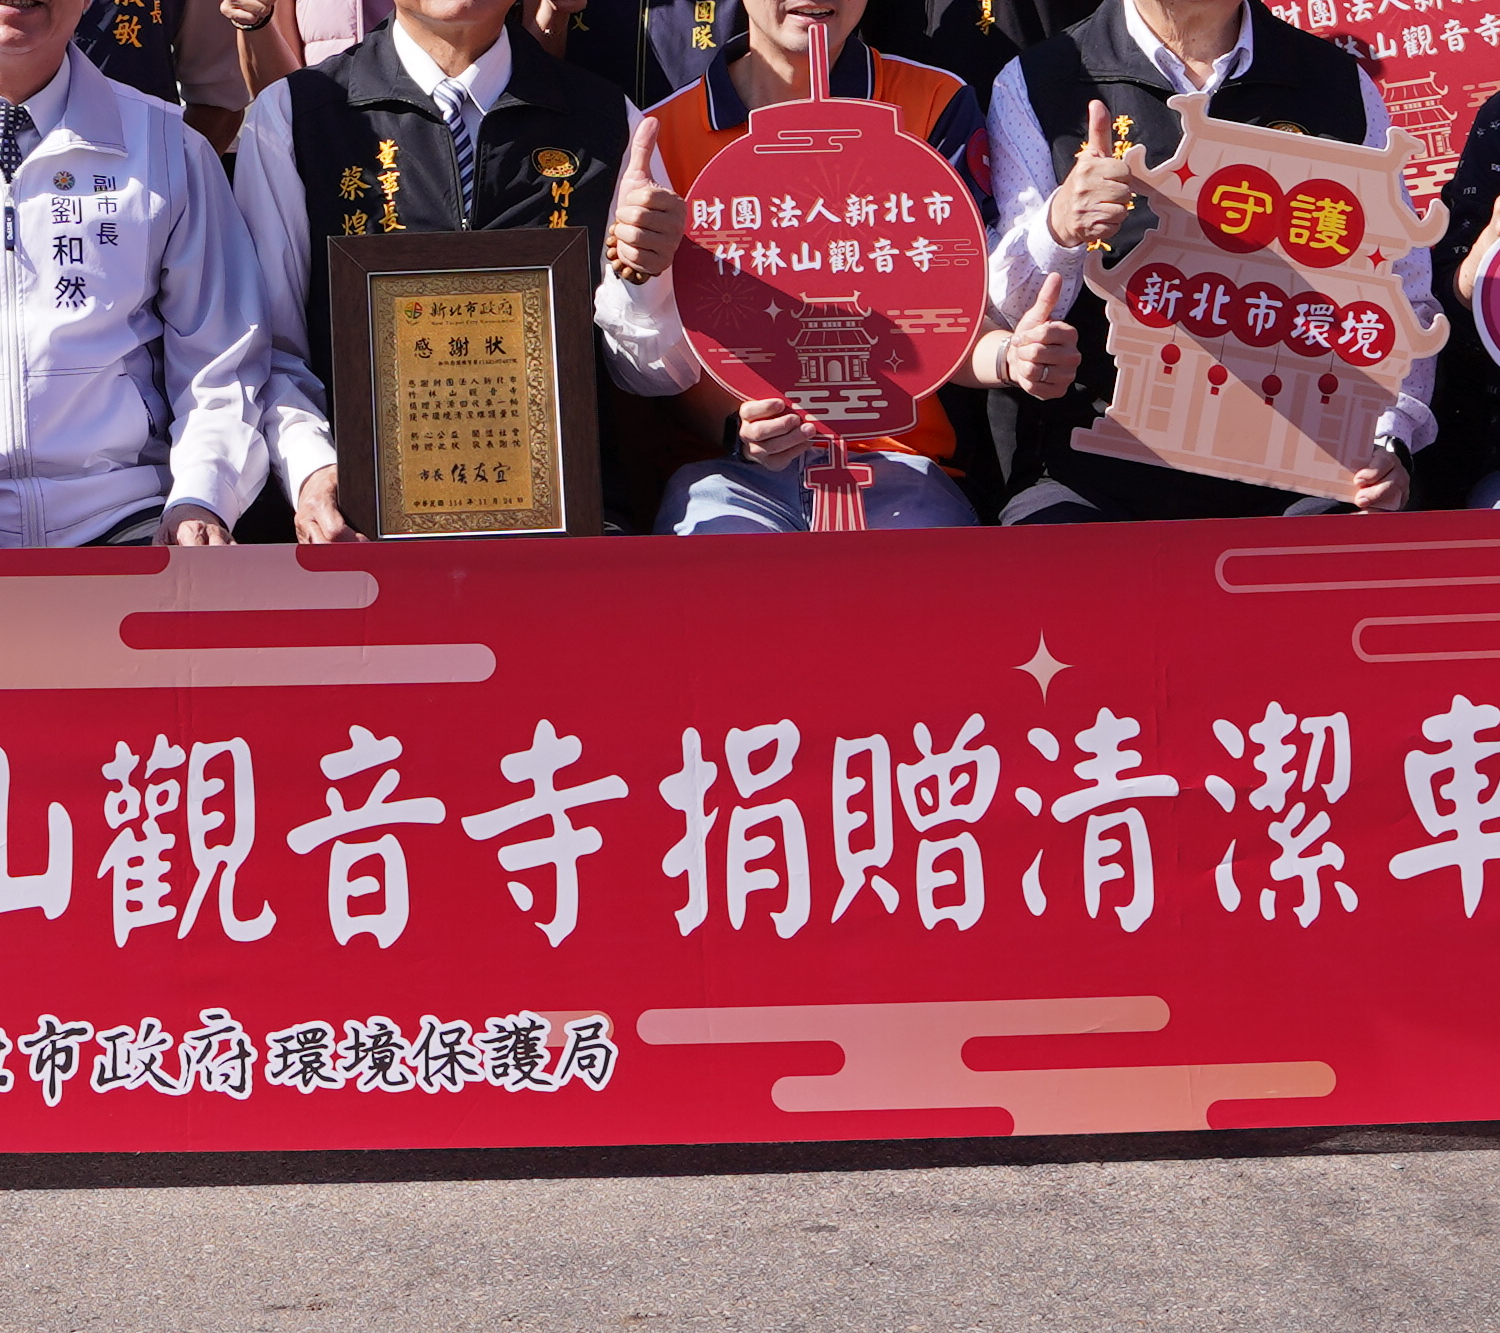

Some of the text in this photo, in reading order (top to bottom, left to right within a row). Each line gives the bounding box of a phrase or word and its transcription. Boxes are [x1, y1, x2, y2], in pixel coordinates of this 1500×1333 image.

[92, 173, 119, 248] 副市長
[375, 139, 407, 233] 董事長
[691, 190, 954, 232] 財團法人新北市
[1211, 180, 1354, 257] 守護
[50, 196, 87, 309] 劉和然
[713, 236, 938, 276] 竹林山觀音寺
[429, 298, 514, 318] 新北市政府
[1138, 272, 1386, 361] 新北市環境
[414, 336, 507, 358] 感謝狀
[451, 462, 511, 485] 侯友宜
